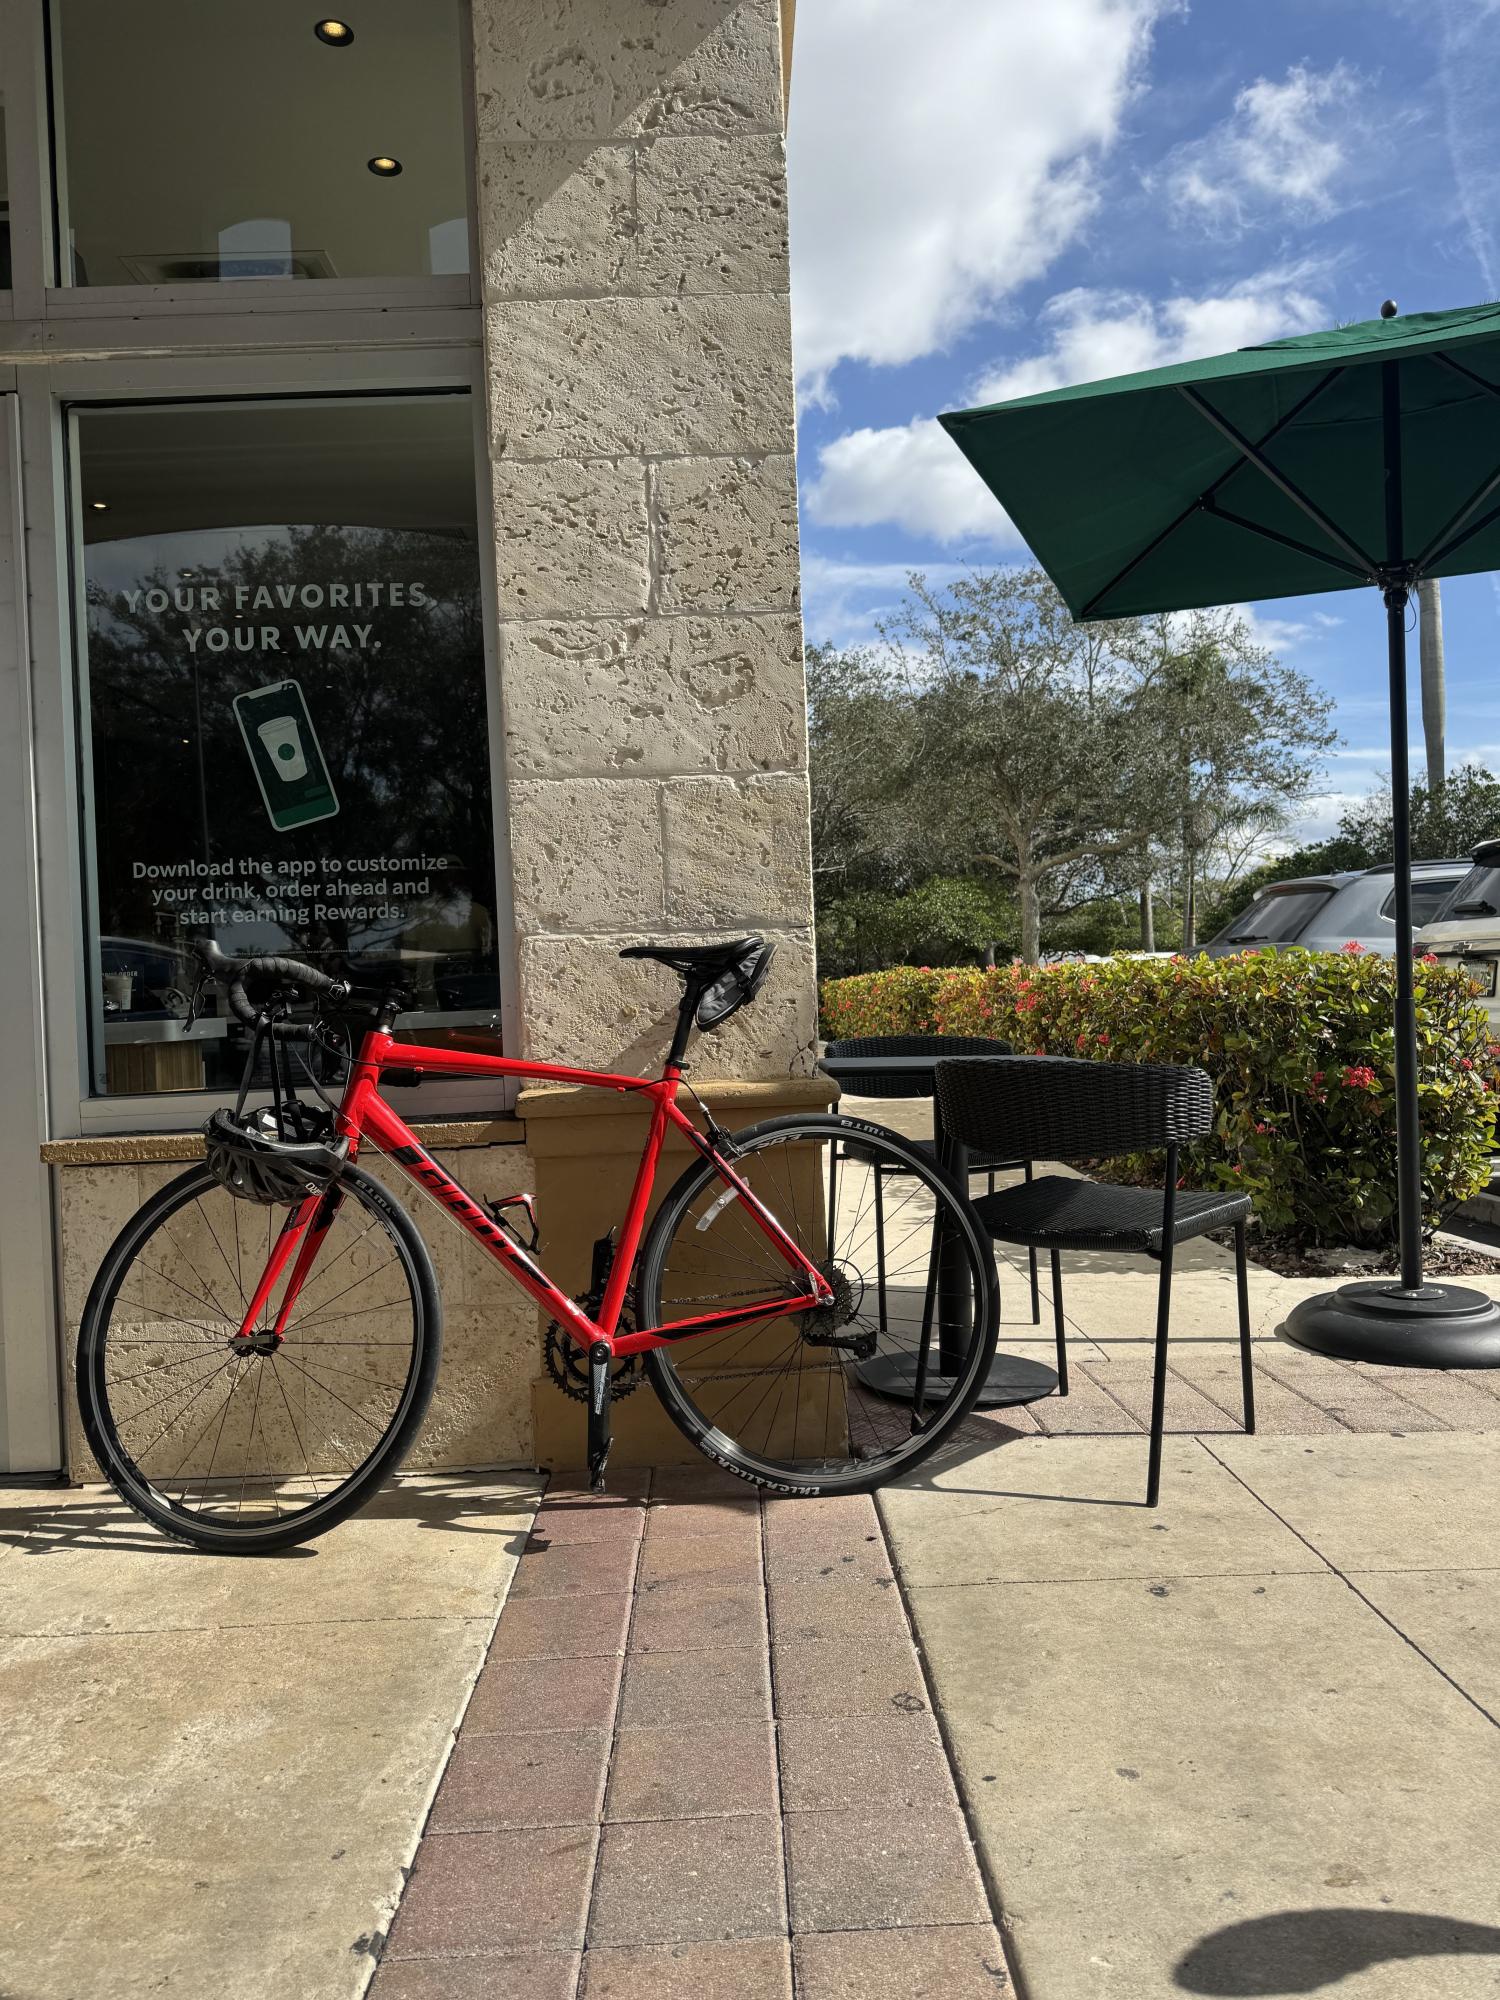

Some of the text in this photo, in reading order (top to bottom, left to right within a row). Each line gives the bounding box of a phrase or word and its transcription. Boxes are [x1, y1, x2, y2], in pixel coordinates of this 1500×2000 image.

[122, 582, 426, 614] YOUR FAVORITES
[182, 623, 382, 653] YOUR WAY.
[132, 853, 448, 879] Download the app to customize
[152, 876, 430, 906] your drink, order ahead and
[179, 901, 405, 925] start earning Rewards.
[840, 1119, 879, 1136] WTB
[355, 1179, 389, 1209] WTB
